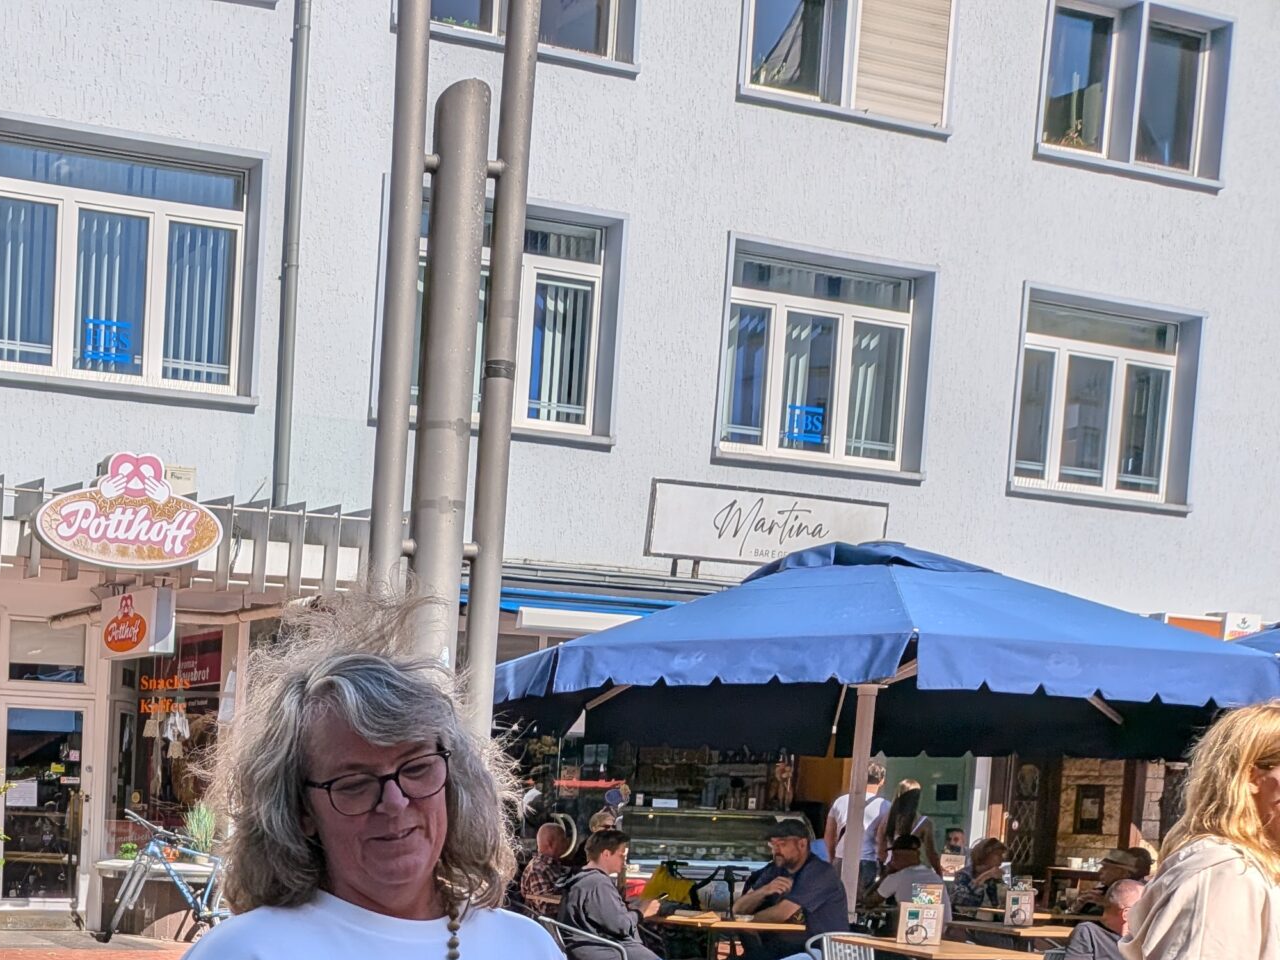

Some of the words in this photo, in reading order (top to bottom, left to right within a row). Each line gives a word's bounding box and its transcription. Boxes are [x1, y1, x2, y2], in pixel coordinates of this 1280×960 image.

[57, 502, 194, 554] Potthoff
[713, 497, 829, 557] Martina
[753, 548, 769, 557] BAR
[107, 618, 141, 643] Potthoff
[140, 676, 191, 690] Snacks
[139, 701, 187, 714] Kaffee
